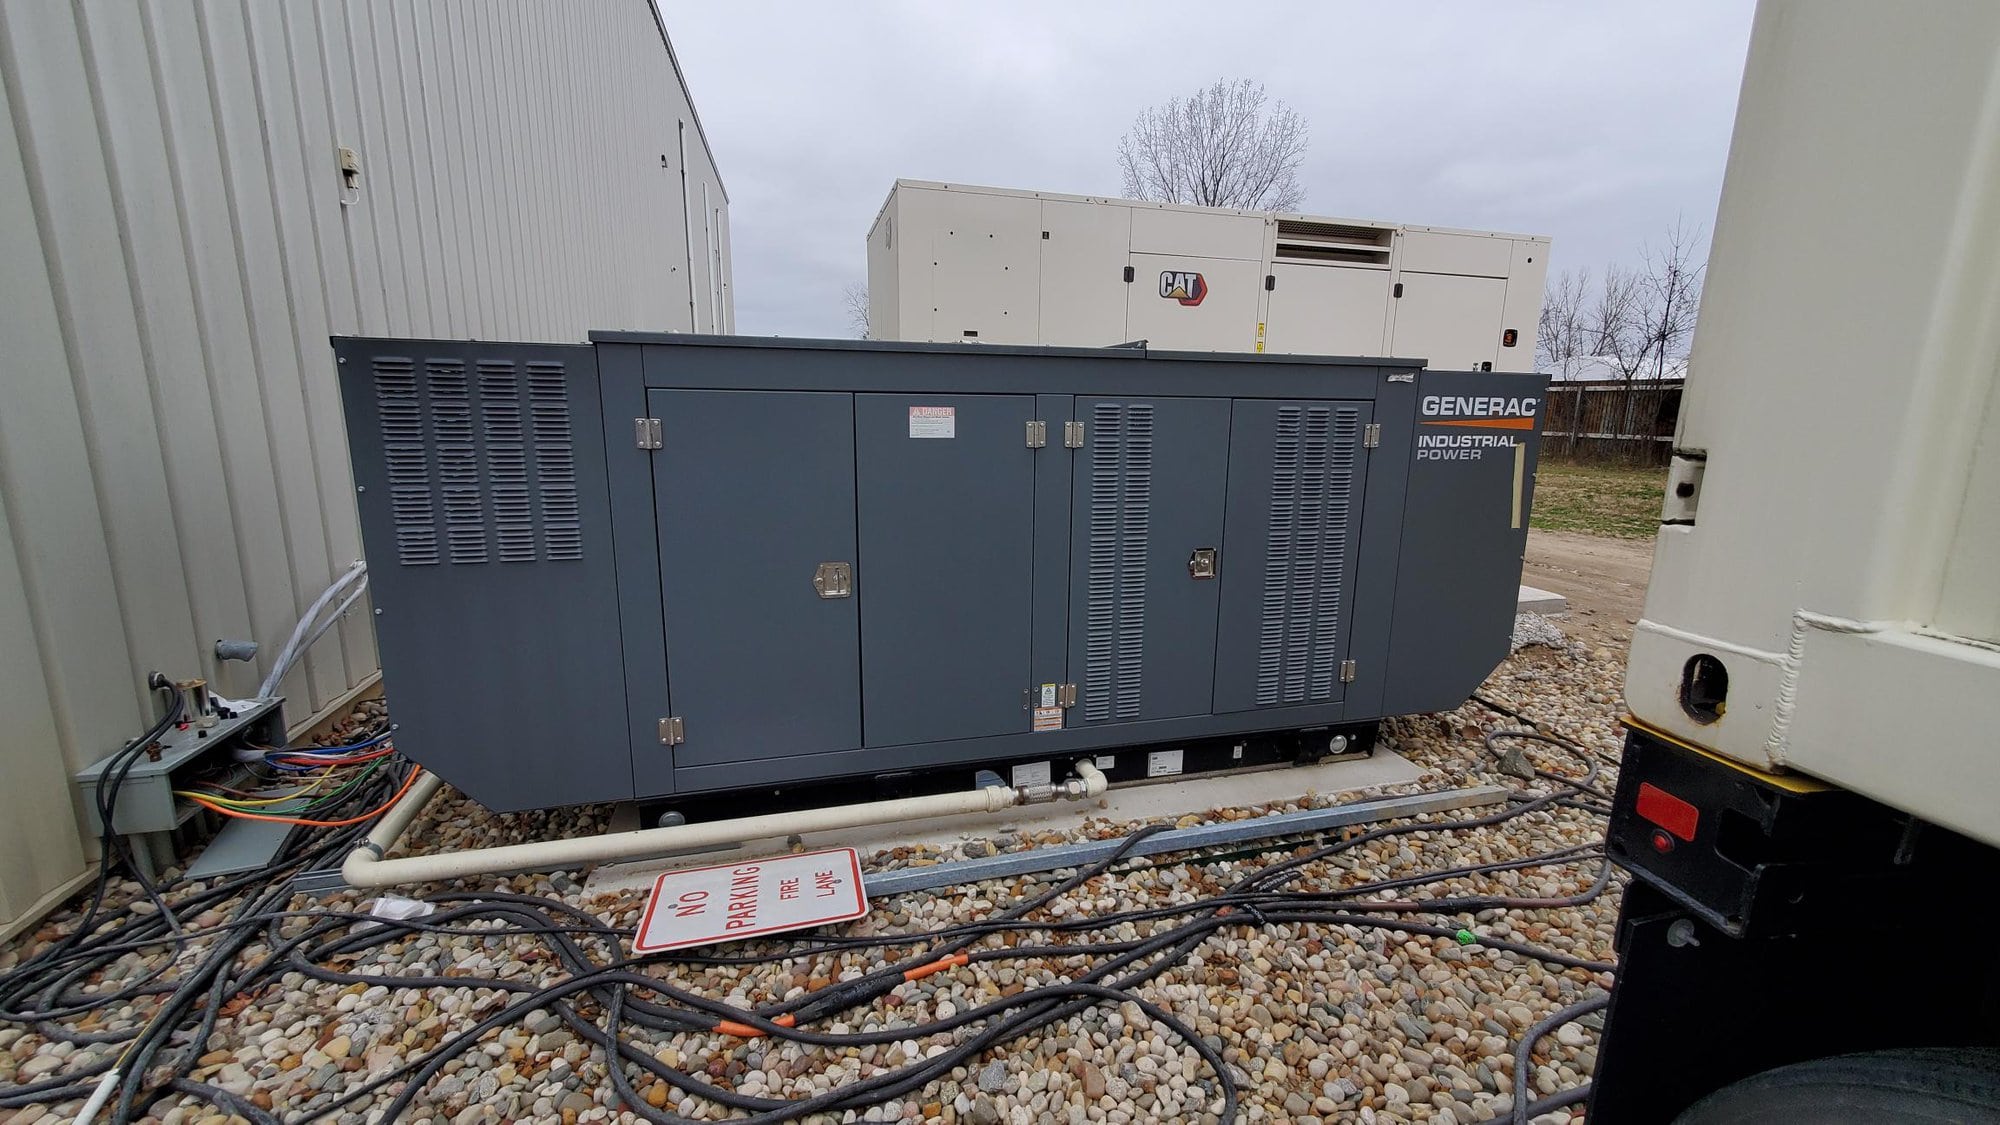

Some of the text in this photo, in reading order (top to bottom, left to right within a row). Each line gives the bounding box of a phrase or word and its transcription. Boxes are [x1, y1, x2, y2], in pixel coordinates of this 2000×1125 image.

[1160, 272, 1197, 299] CAT
[922, 407, 952, 416] DANGER
[1422, 396, 1536, 416] GENERAC
[1418, 435, 1519, 447] INDUSTRIAL
[1417, 449, 1481, 460] POWER
[780, 877, 800, 900] FIRE
[815, 870, 835, 898] LANE
[675, 890, 709, 918] NO
[725, 866, 761, 930] PARKING
